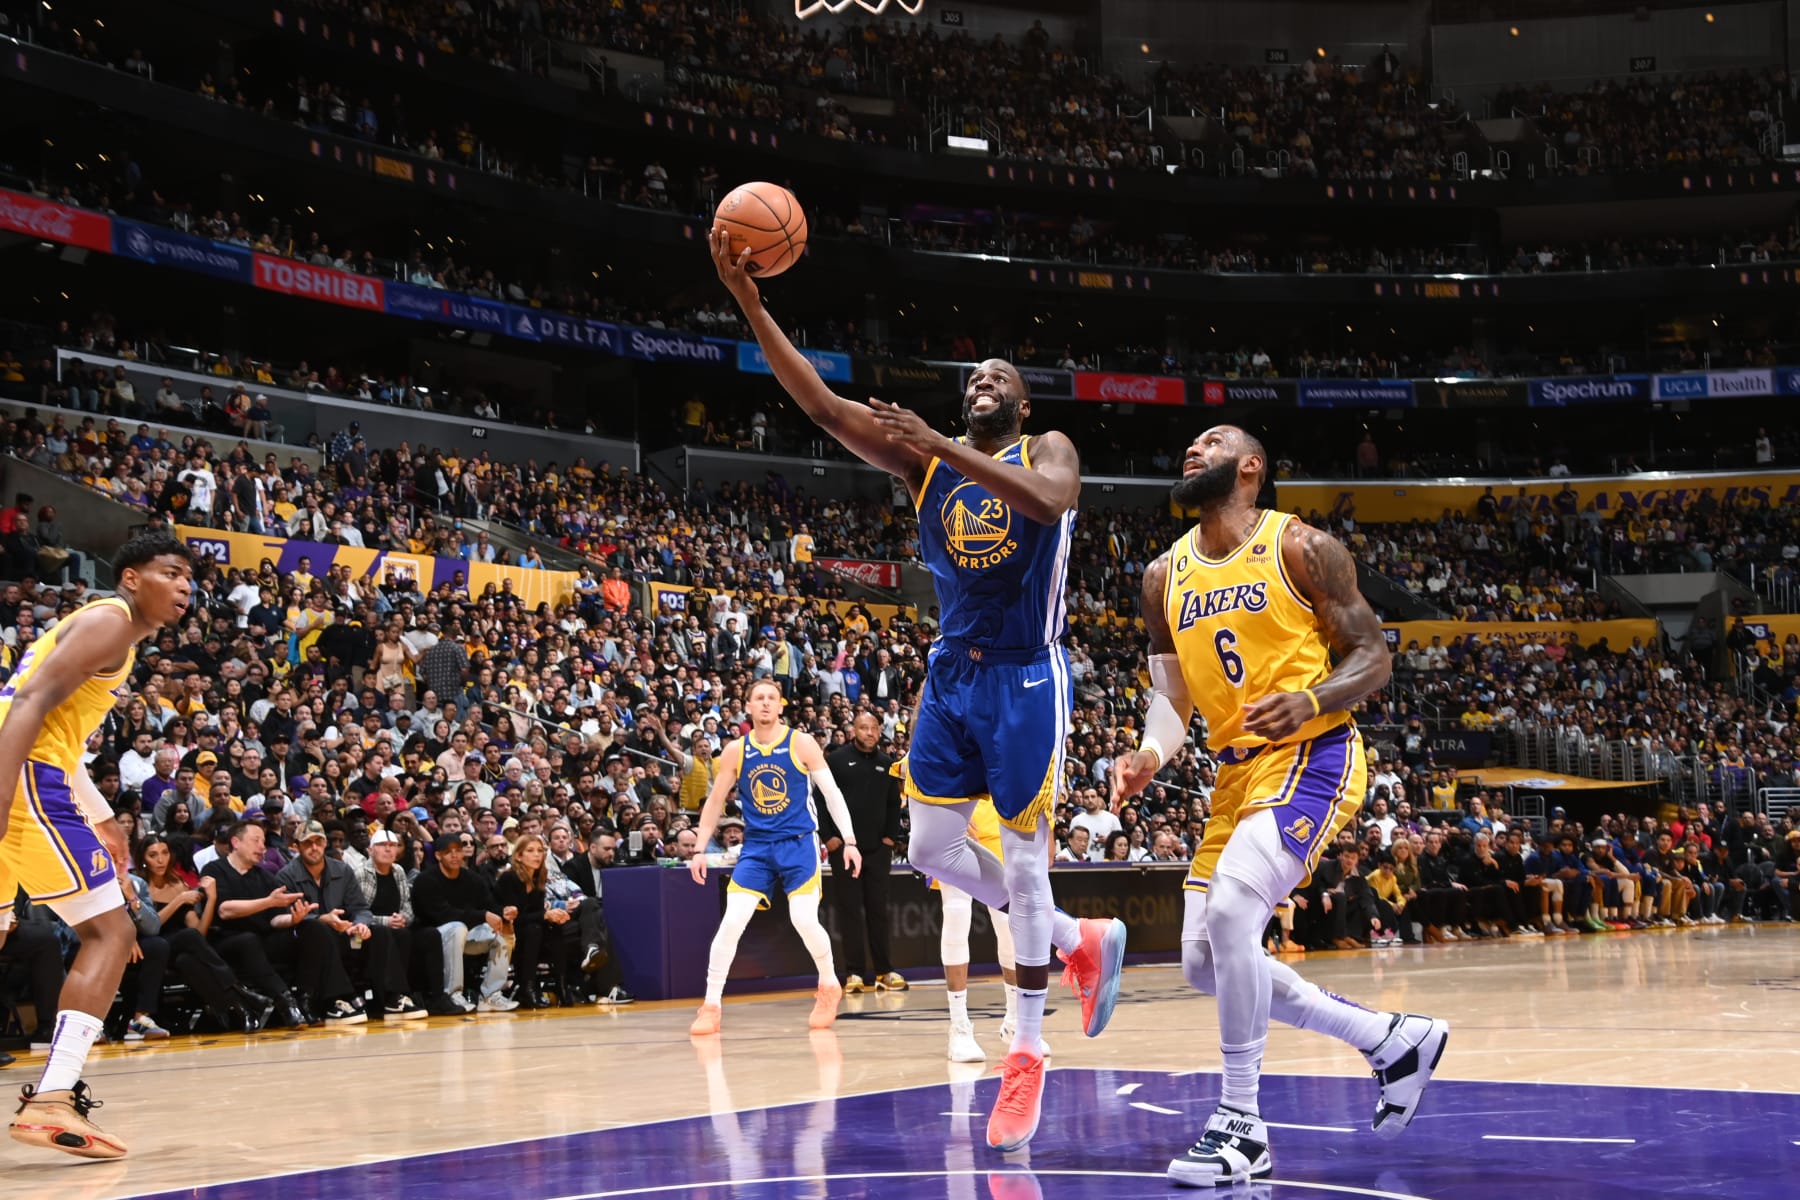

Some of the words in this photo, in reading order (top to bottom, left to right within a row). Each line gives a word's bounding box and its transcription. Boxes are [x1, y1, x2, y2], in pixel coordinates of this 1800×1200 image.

[259, 259, 378, 305] TOSHIBA
[451, 301, 502, 326] ULTRA
[541, 318, 611, 349] DELTA
[631, 330, 721, 362] Spectrum
[1228, 387, 1280, 401] TOYOTA
[1305, 387, 1359, 400] AMERICAN
[1360, 387, 1408, 399] EXPRESS
[1539, 381, 1635, 406] Spectrum
[1664, 379, 1703, 394] UCLA
[1712, 376, 1767, 393] Health
[979, 498, 1004, 519] 23
[946, 538, 1018, 569] WARRIORS
[1246, 555, 1271, 564] bibigo
[832, 561, 881, 585] Coca-Cola
[1177, 582, 1268, 632] LAKERS
[1214, 629, 1244, 686] 6
[772, 777, 780, 789] 0
[752, 797, 791, 815] WARRIORS
[1226, 1119, 1255, 1136] NIKE
